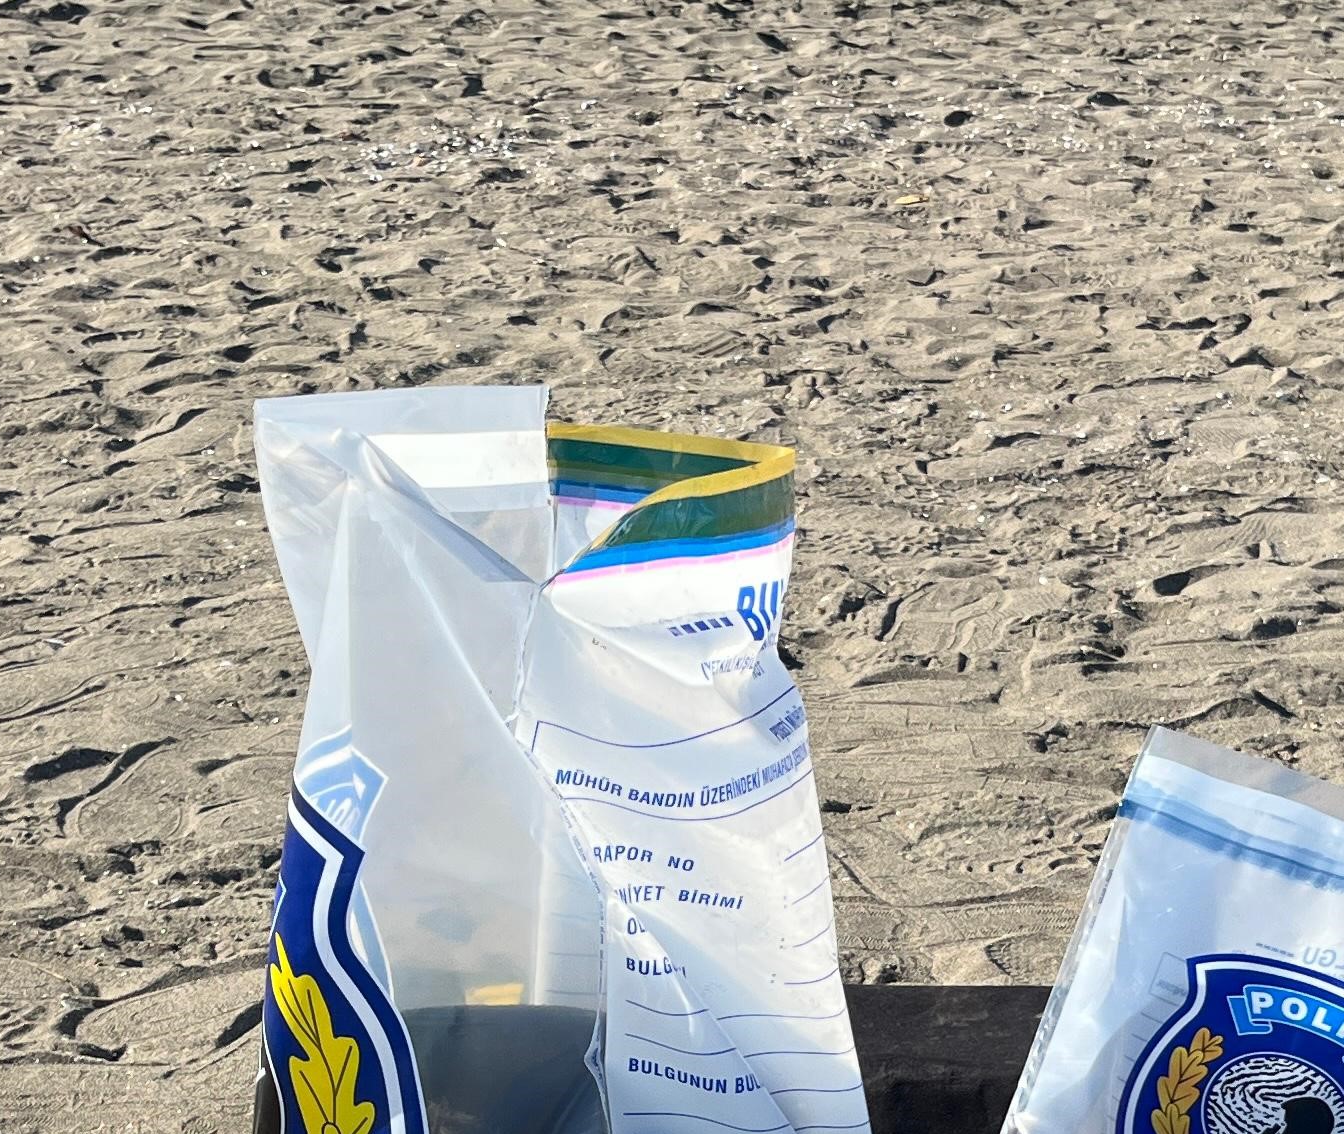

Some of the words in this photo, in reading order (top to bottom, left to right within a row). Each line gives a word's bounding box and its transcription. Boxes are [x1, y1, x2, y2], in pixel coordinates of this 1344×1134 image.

[737, 580, 783, 641] BU
[556, 769, 622, 797] MÜHÜR
[628, 788, 695, 808] BANDIN
[667, 855, 695, 872] NO
[615, 883, 666, 905] NİYET
[678, 890, 745, 911] BİRİMİ
[628, 1057, 727, 1094] BULGUNUN
